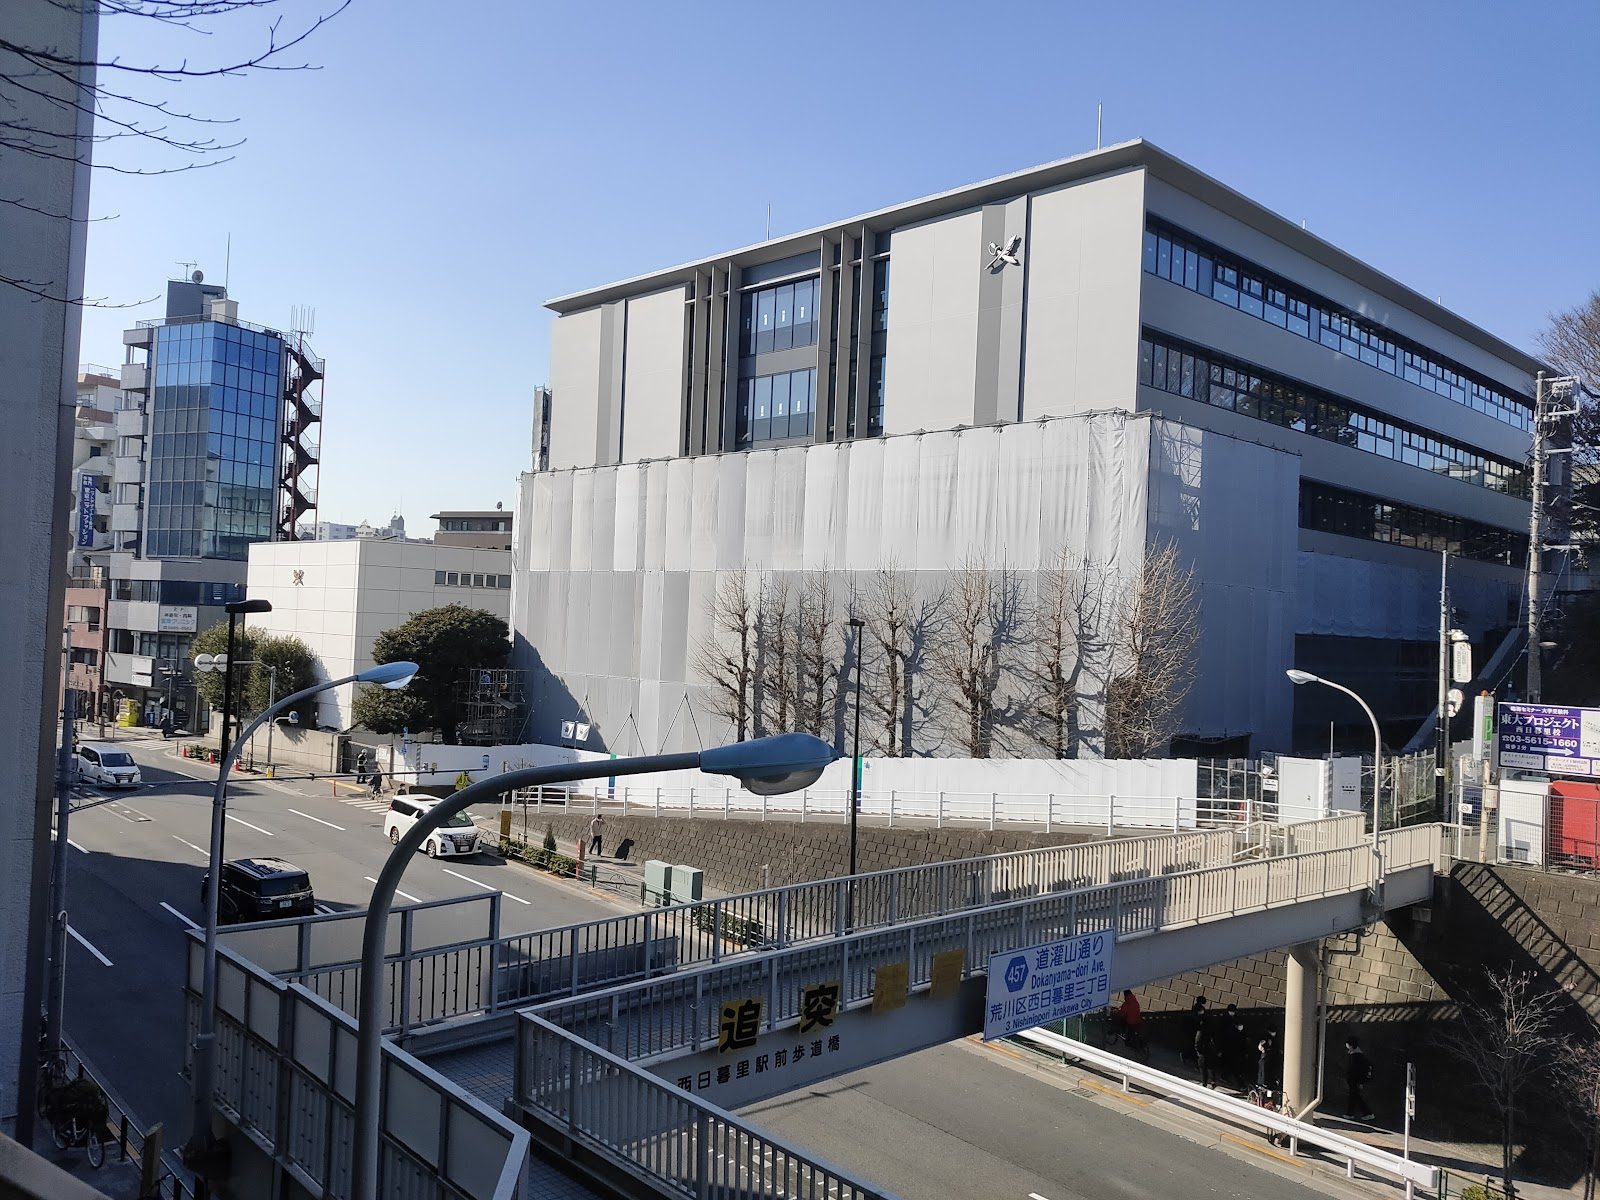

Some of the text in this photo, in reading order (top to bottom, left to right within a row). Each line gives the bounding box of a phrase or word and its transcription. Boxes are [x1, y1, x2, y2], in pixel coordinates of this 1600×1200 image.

[1500, 713, 1580, 730] 東大プロジェクト
[1035, 936, 1104, 971] 道灌山通り
[1007, 964, 1026, 984] 457
[1031, 959, 1106, 990] Dokanyama-dori Ave.
[990, 974, 1108, 1023] 荒川区西日暮里三丁目
[1005, 997, 1094, 1032] 3 Nishinippori Arakawa City
[677, 1034, 841, 1093] 西日暮里駅前歩道橋
